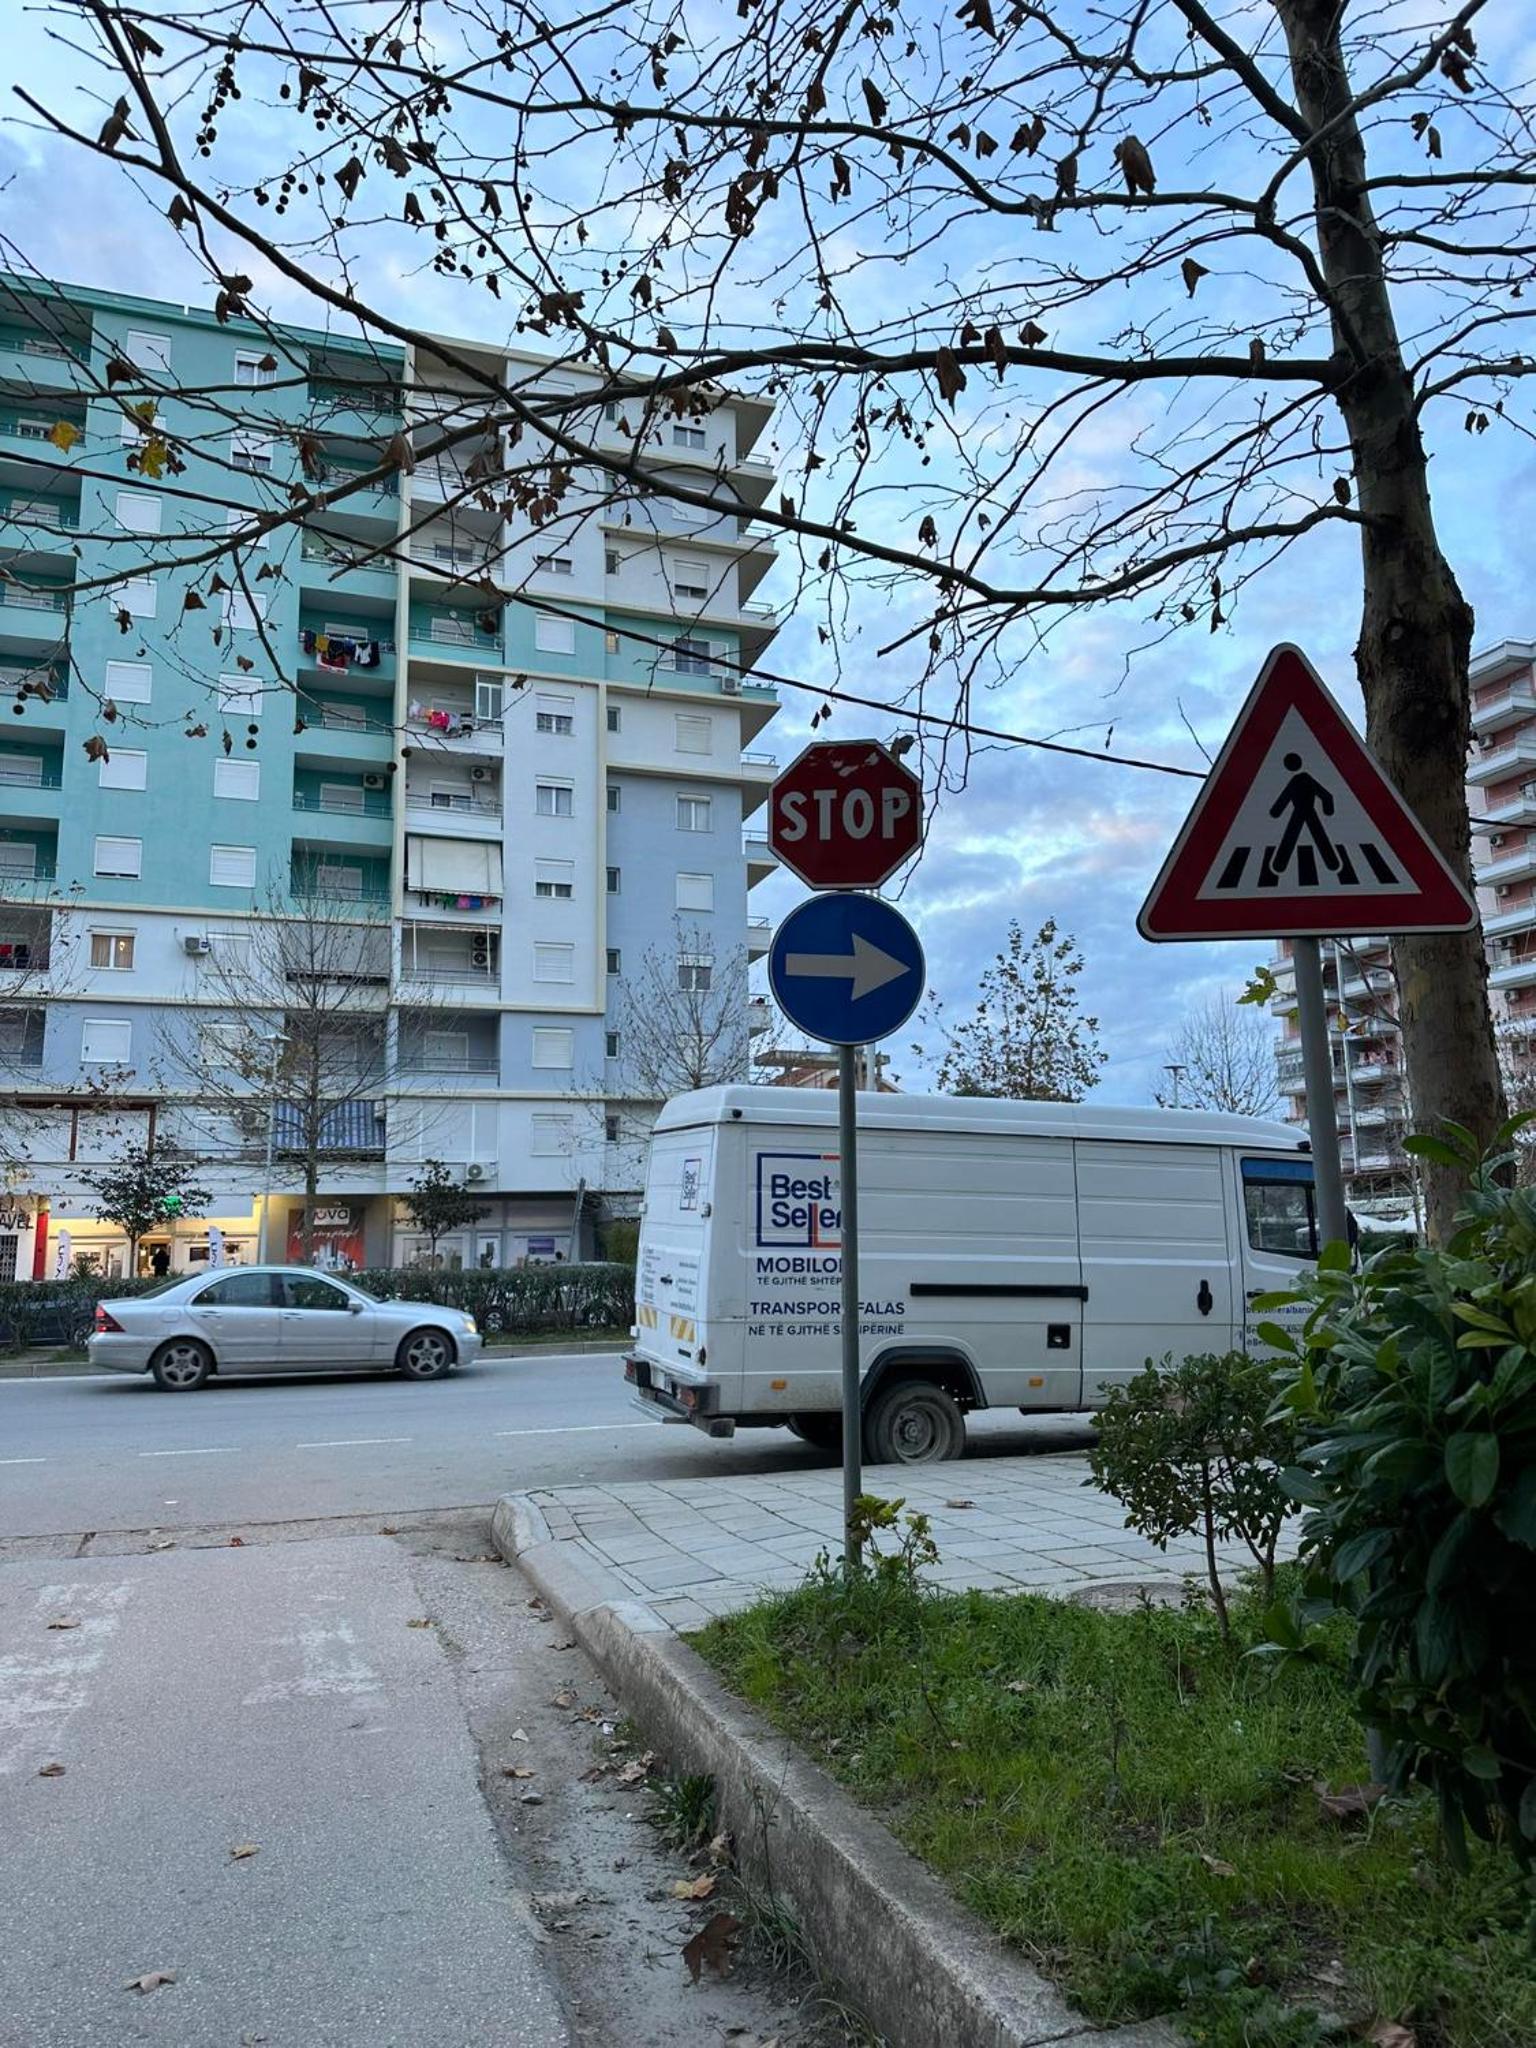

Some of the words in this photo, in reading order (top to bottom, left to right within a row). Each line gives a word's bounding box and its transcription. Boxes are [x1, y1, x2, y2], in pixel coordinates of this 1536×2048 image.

[779, 787, 911, 842] STOP
[771, 1174, 832, 1199] Best
[757, 1257, 841, 1273] MOBILO
[758, 1276, 770, 1285] TË
[772, 1275, 807, 1286] GJITHË
[810, 1275, 842, 1285] SHTËP
[750, 1302, 841, 1315] TRANSPOR
[748, 1323, 766, 1336] NË
[770, 1323, 784, 1335] TË
[787, 1323, 830, 1335] GJITHË
[833, 1323, 905, 1335] SIPËRINË
